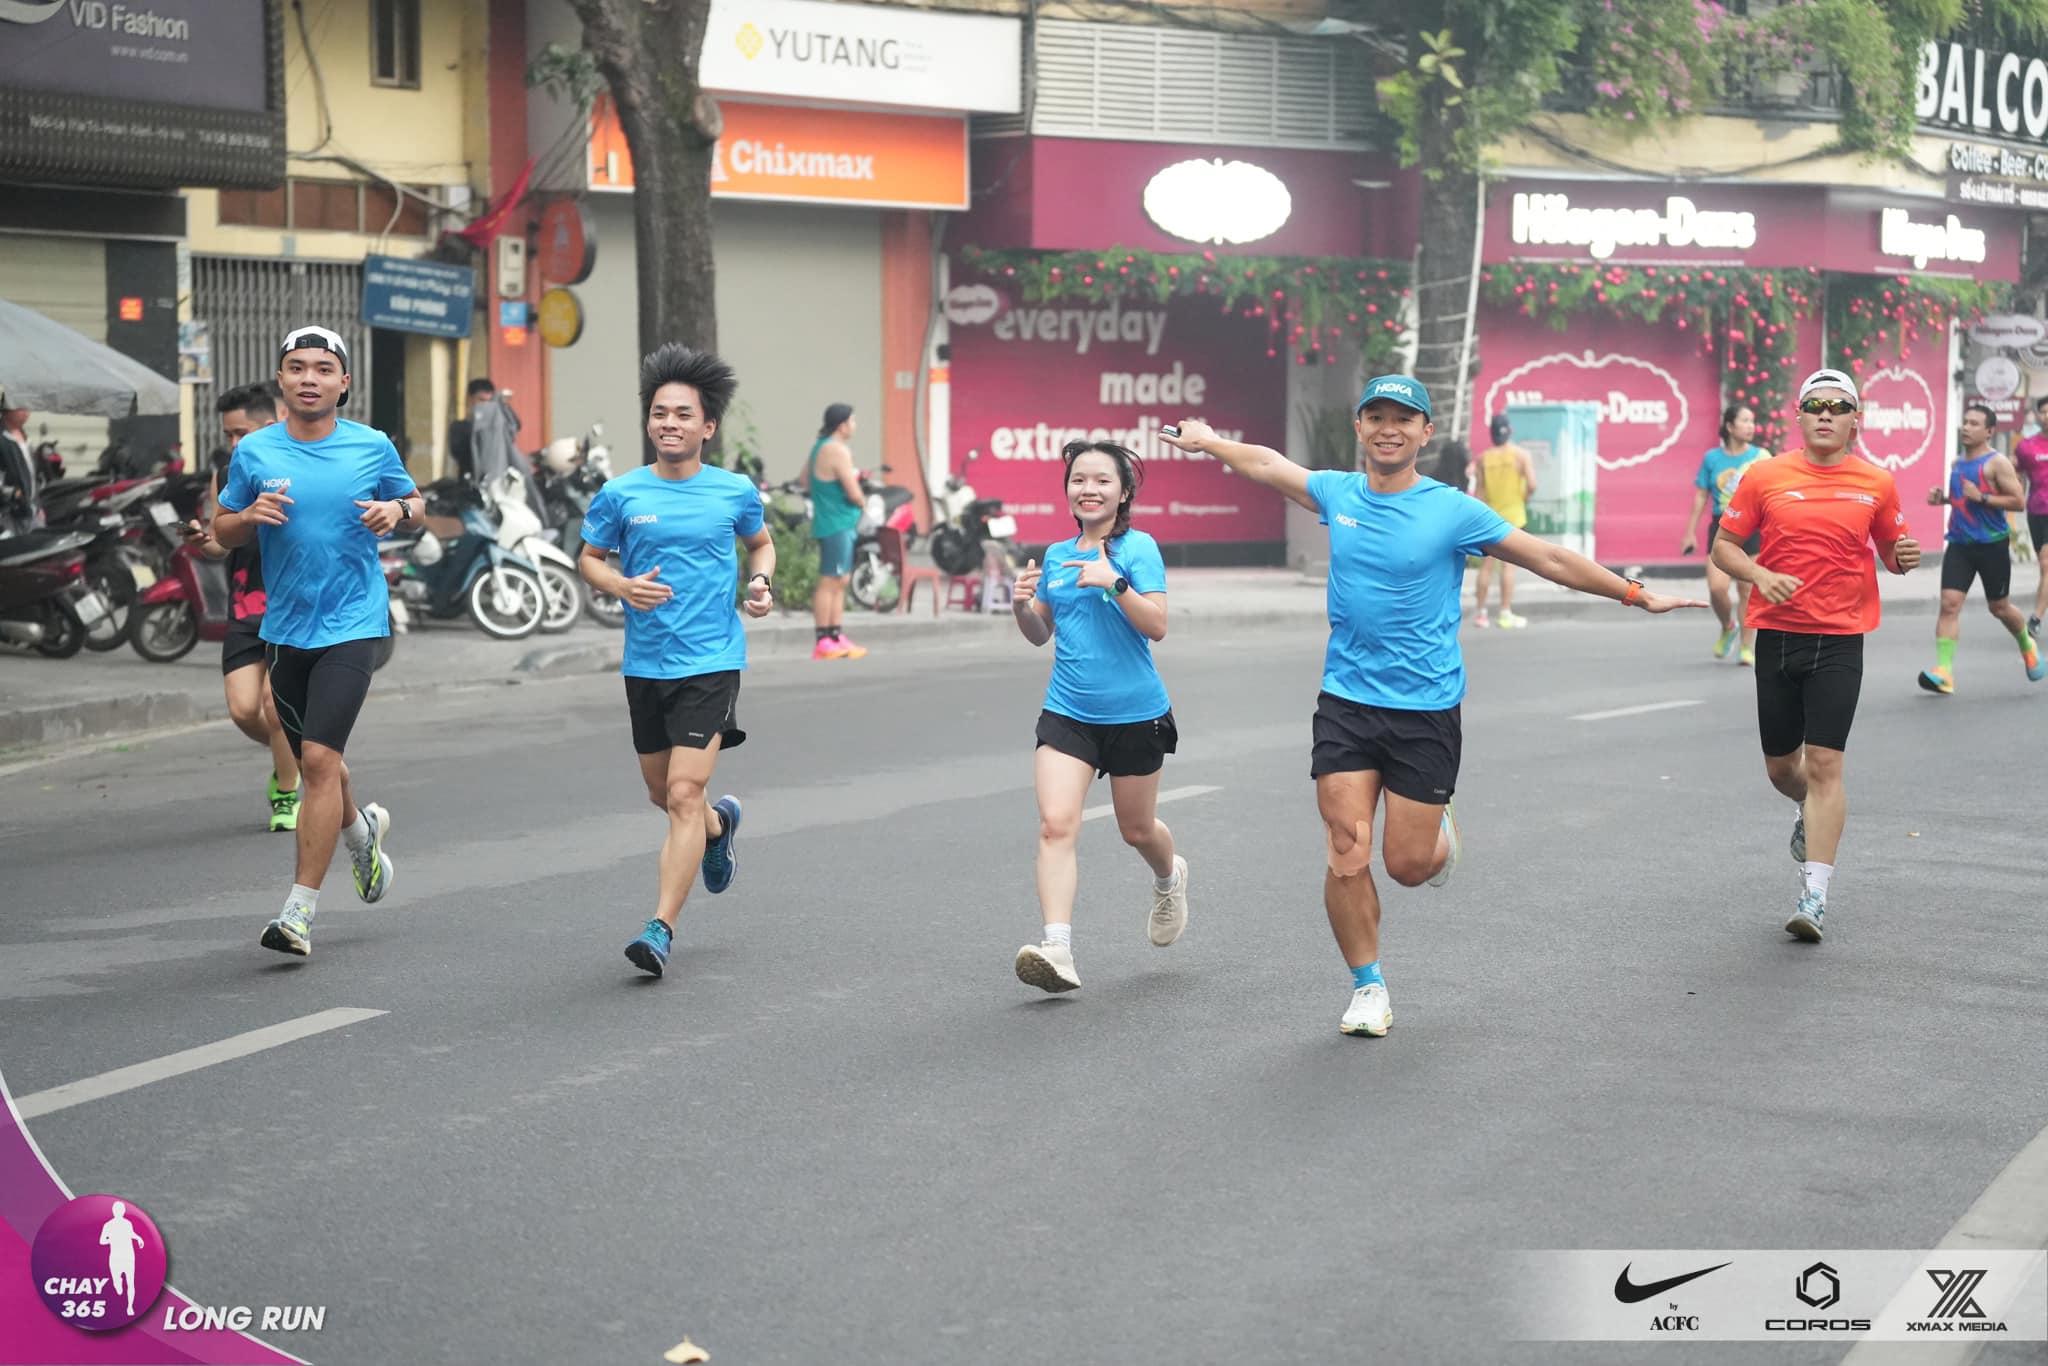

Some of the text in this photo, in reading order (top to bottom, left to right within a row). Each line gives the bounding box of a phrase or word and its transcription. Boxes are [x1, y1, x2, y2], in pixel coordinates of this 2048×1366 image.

[69, 0, 189, 40] VID Fashion
[769, 28, 900, 70] YUTANG
[1915, 38, 2048, 138] BALCO
[730, 140, 875, 181] Chixmax
[1951, 143, 1992, 174] Coffee
[2000, 148, 2028, 177] Beer
[994, 299, 1167, 354] everyday
[1099, 361, 1206, 405] made
[1374, 382, 1413, 398] HOKA
[263, 477, 292, 489] HOKA
[629, 514, 658, 526] HOKA
